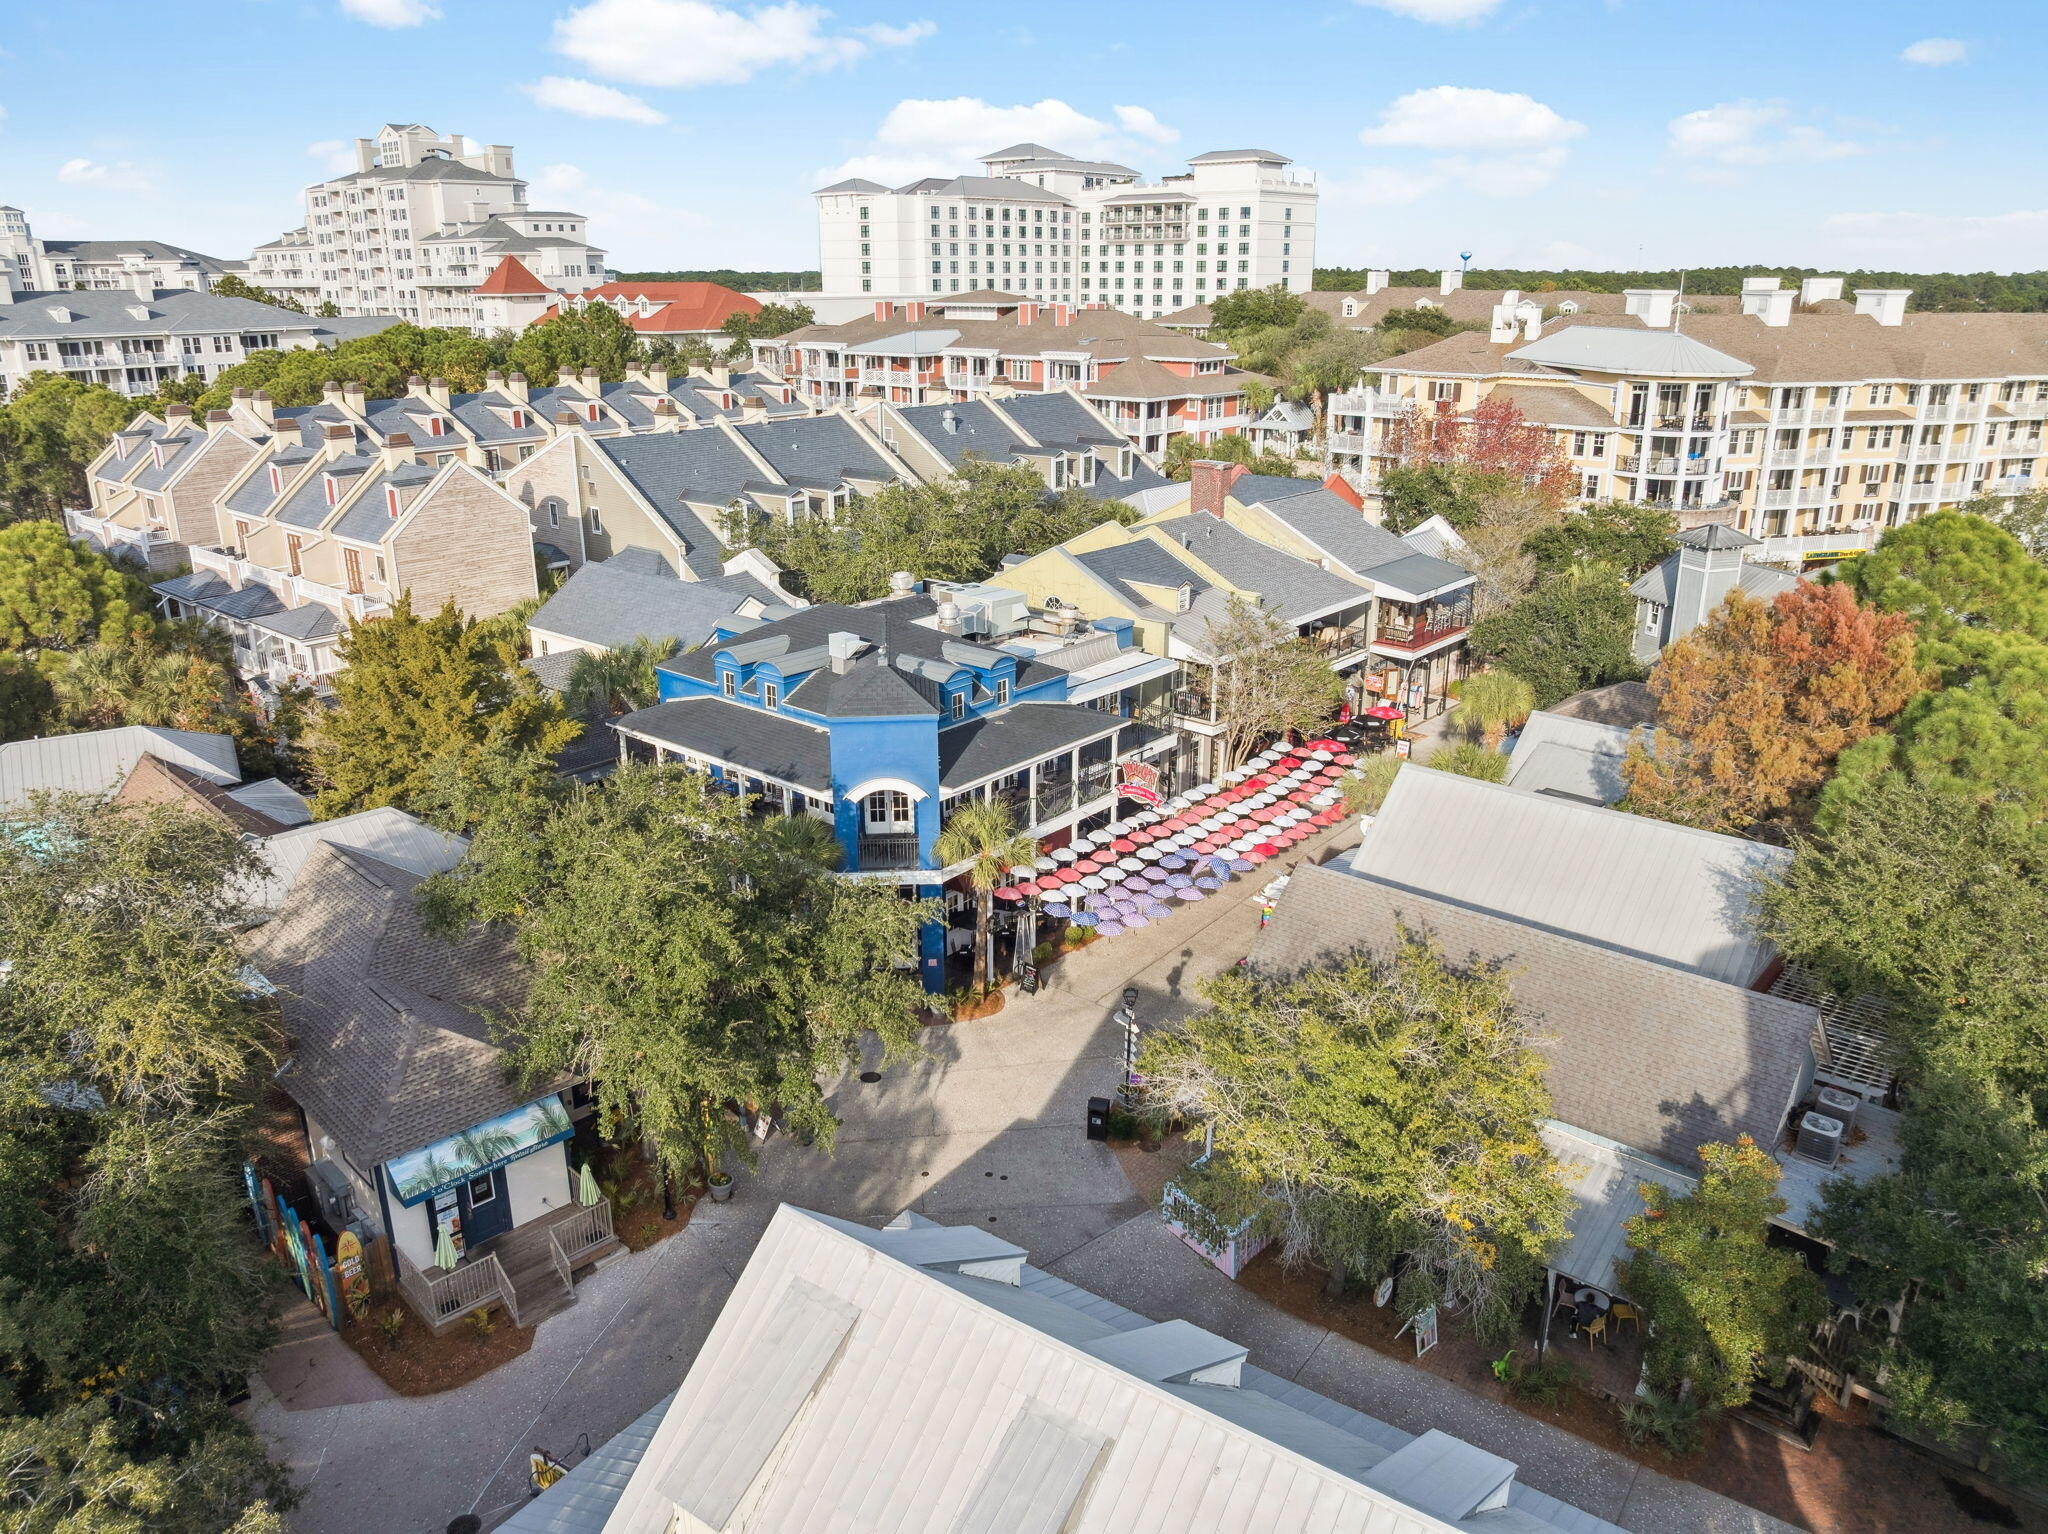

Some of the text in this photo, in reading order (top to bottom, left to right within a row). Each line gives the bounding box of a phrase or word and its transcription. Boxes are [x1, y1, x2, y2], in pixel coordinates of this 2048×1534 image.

[437, 1177, 466, 1192] o'Clock
[468, 1159, 508, 1178] Somewhere
[342, 1255, 360, 1269] COLD
[344, 1264, 362, 1278] BEER
